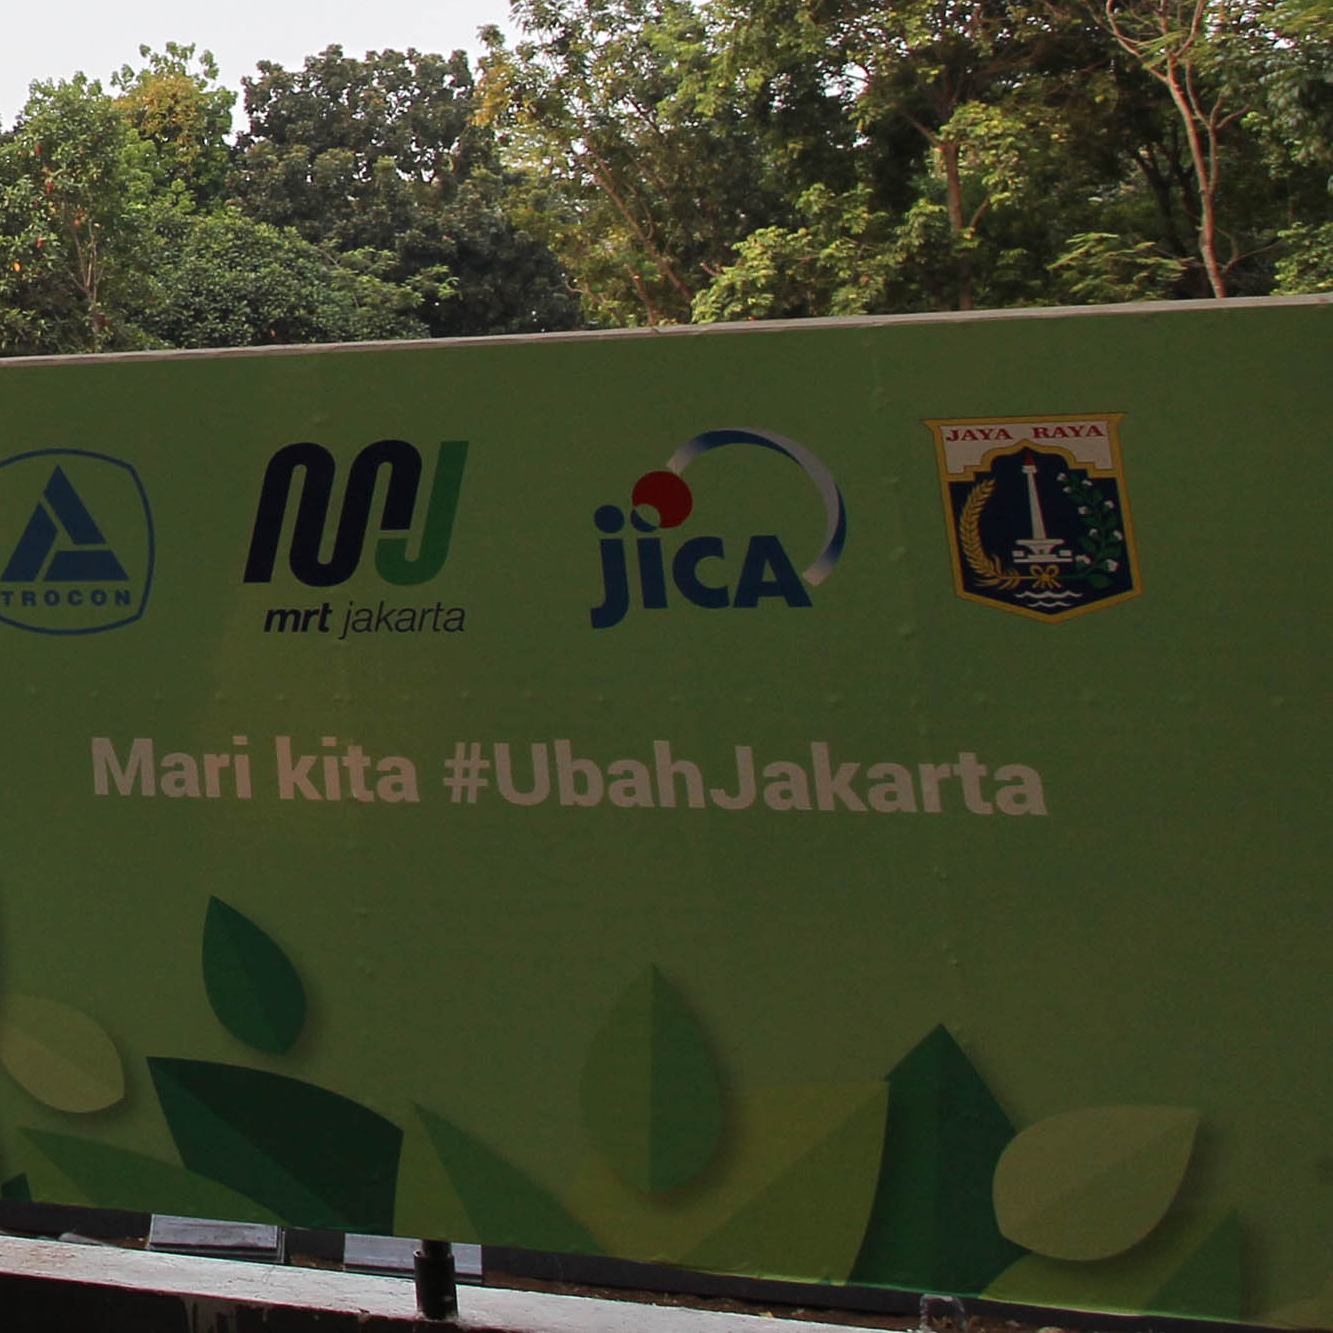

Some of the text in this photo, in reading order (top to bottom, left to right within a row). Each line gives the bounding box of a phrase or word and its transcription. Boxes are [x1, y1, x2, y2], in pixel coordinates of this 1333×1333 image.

[946, 424, 1104, 442] JAYA RAYA
[1, 589, 131, 606] TROCON
[264, 601, 465, 640] mrt jakarta
[91, 736, 1048, 817] Mari kita #UbahJakarta
